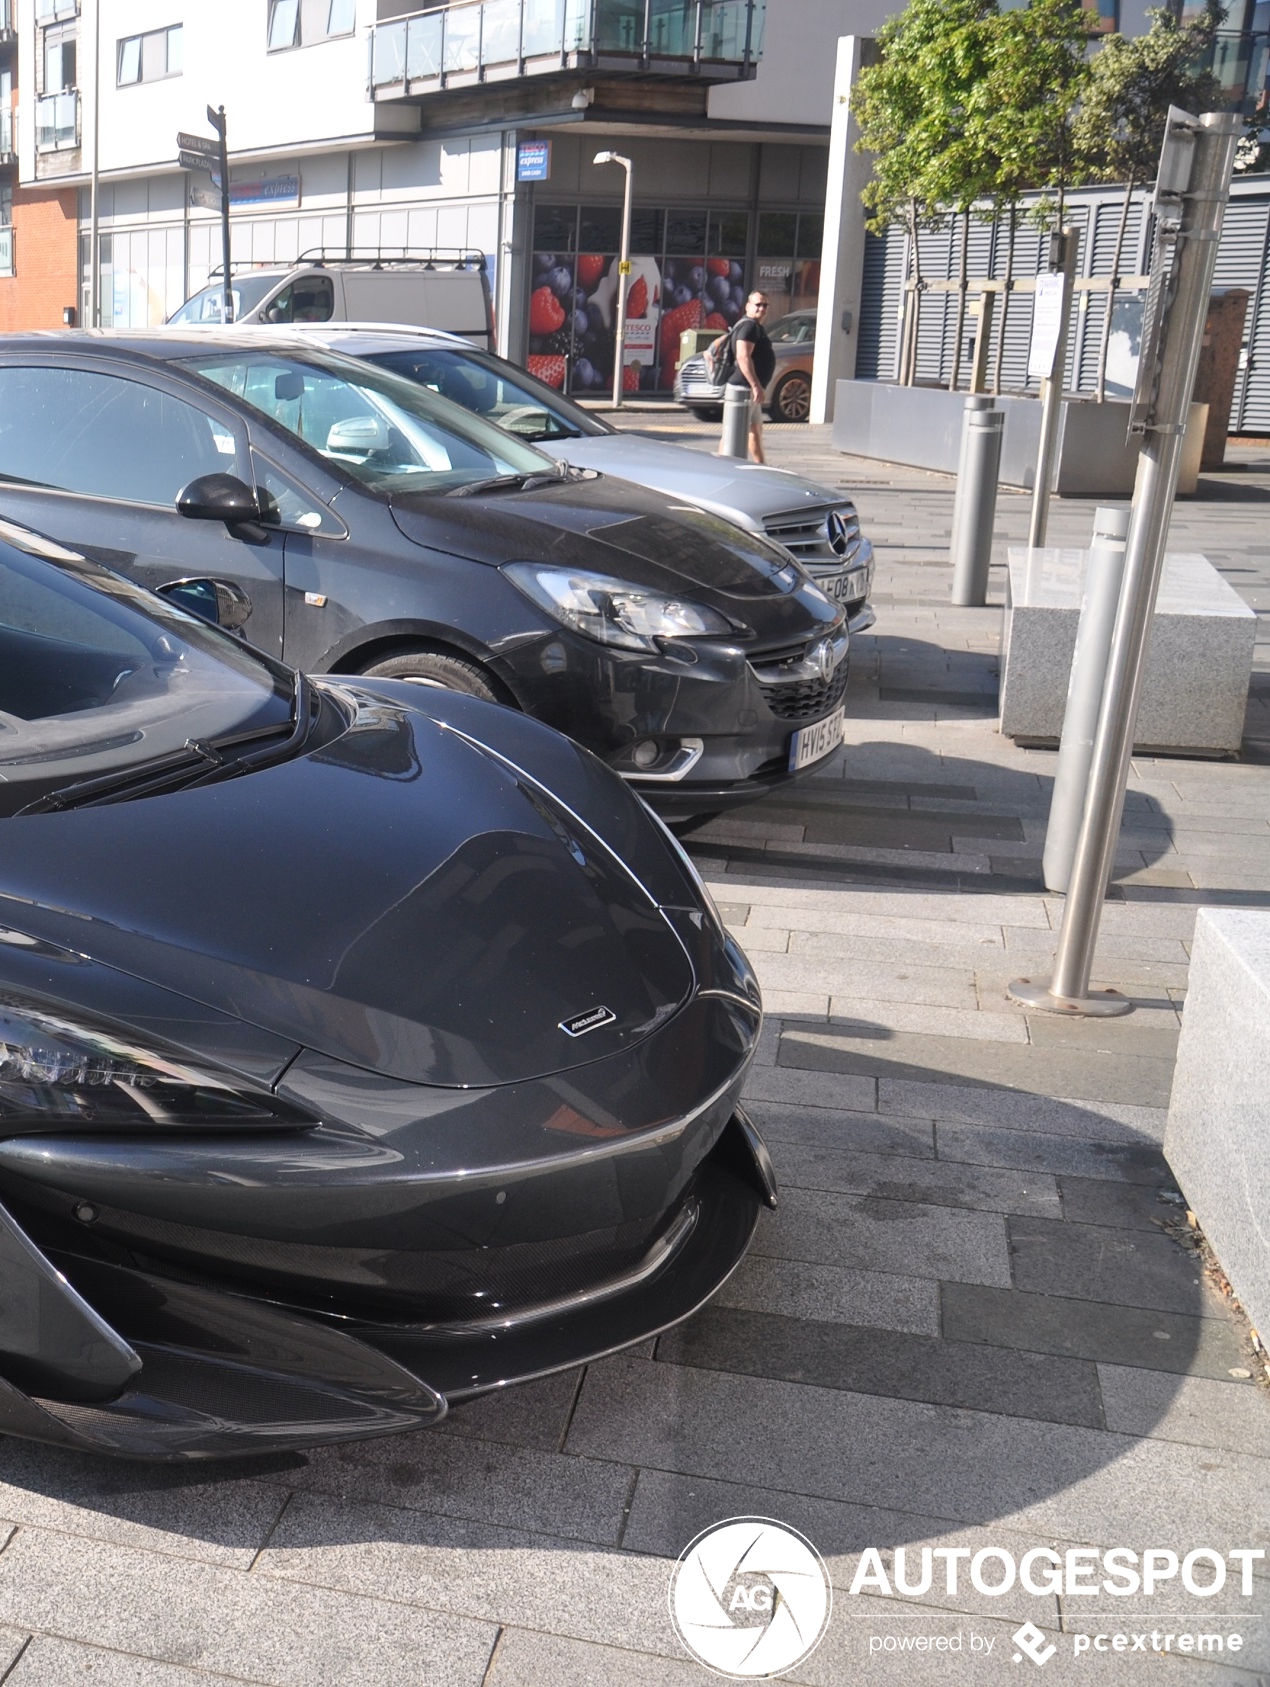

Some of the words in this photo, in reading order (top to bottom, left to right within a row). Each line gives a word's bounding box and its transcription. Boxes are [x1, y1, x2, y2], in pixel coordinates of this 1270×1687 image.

[181, 136, 198, 148] HOTEL
[520, 143, 545, 152] TESCO
[183, 155, 196, 165] PARK
[520, 156, 544, 166] express
[264, 182, 296, 198] express
[759, 266, 790, 278] FRESH
